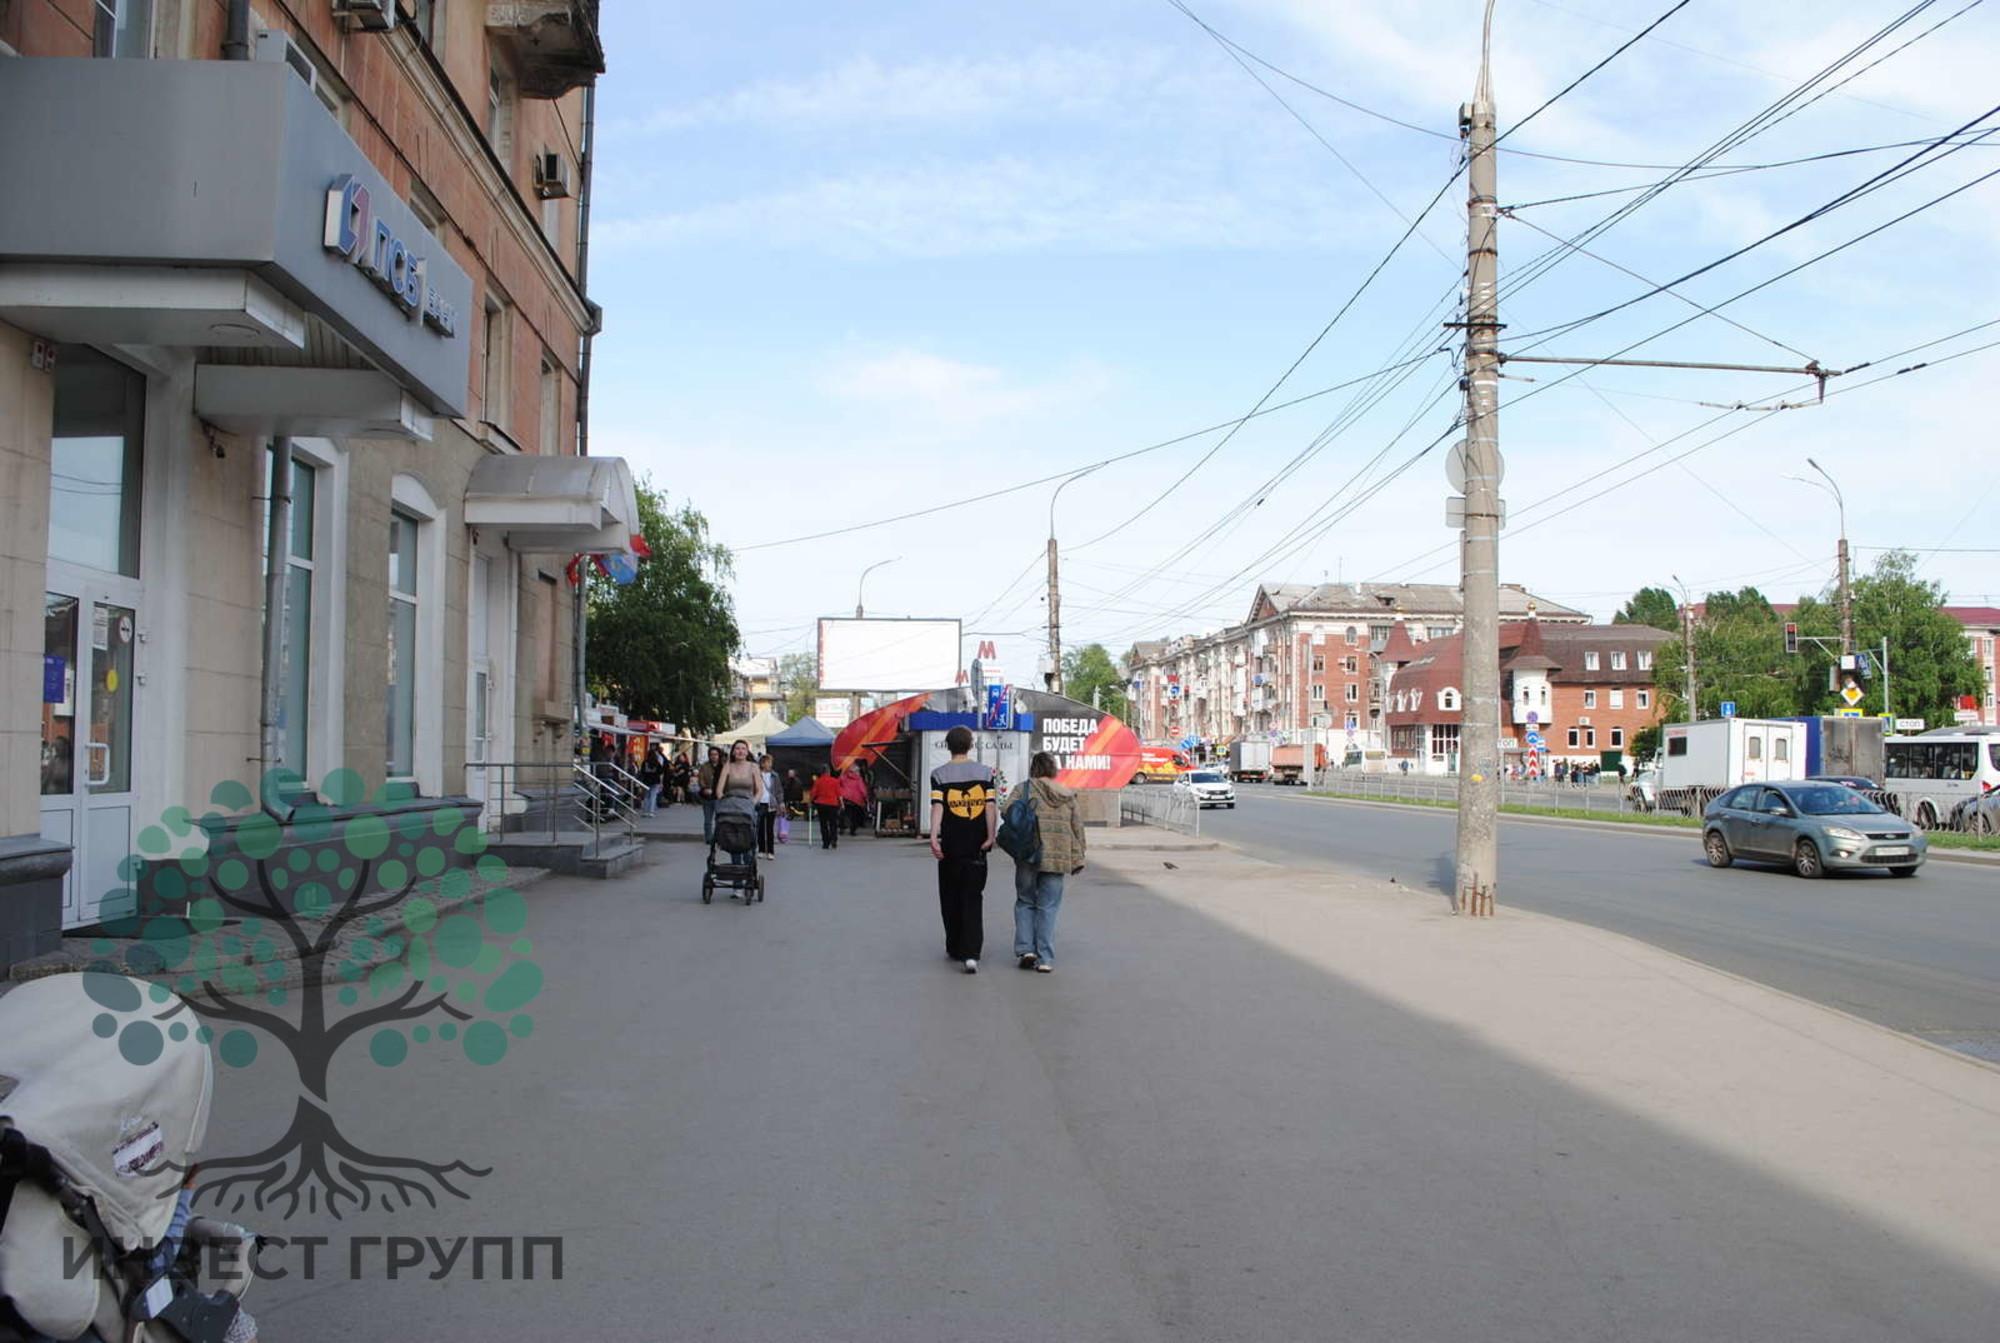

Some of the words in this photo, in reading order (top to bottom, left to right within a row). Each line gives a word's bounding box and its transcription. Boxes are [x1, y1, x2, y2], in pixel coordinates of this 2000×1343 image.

[374, 218, 418, 307] ПСБ
[1043, 718, 1098, 735] ПОБЕДА
[1043, 737, 1085, 753] БУДЕТ
[1066, 755, 1111, 770] НАМИ!
